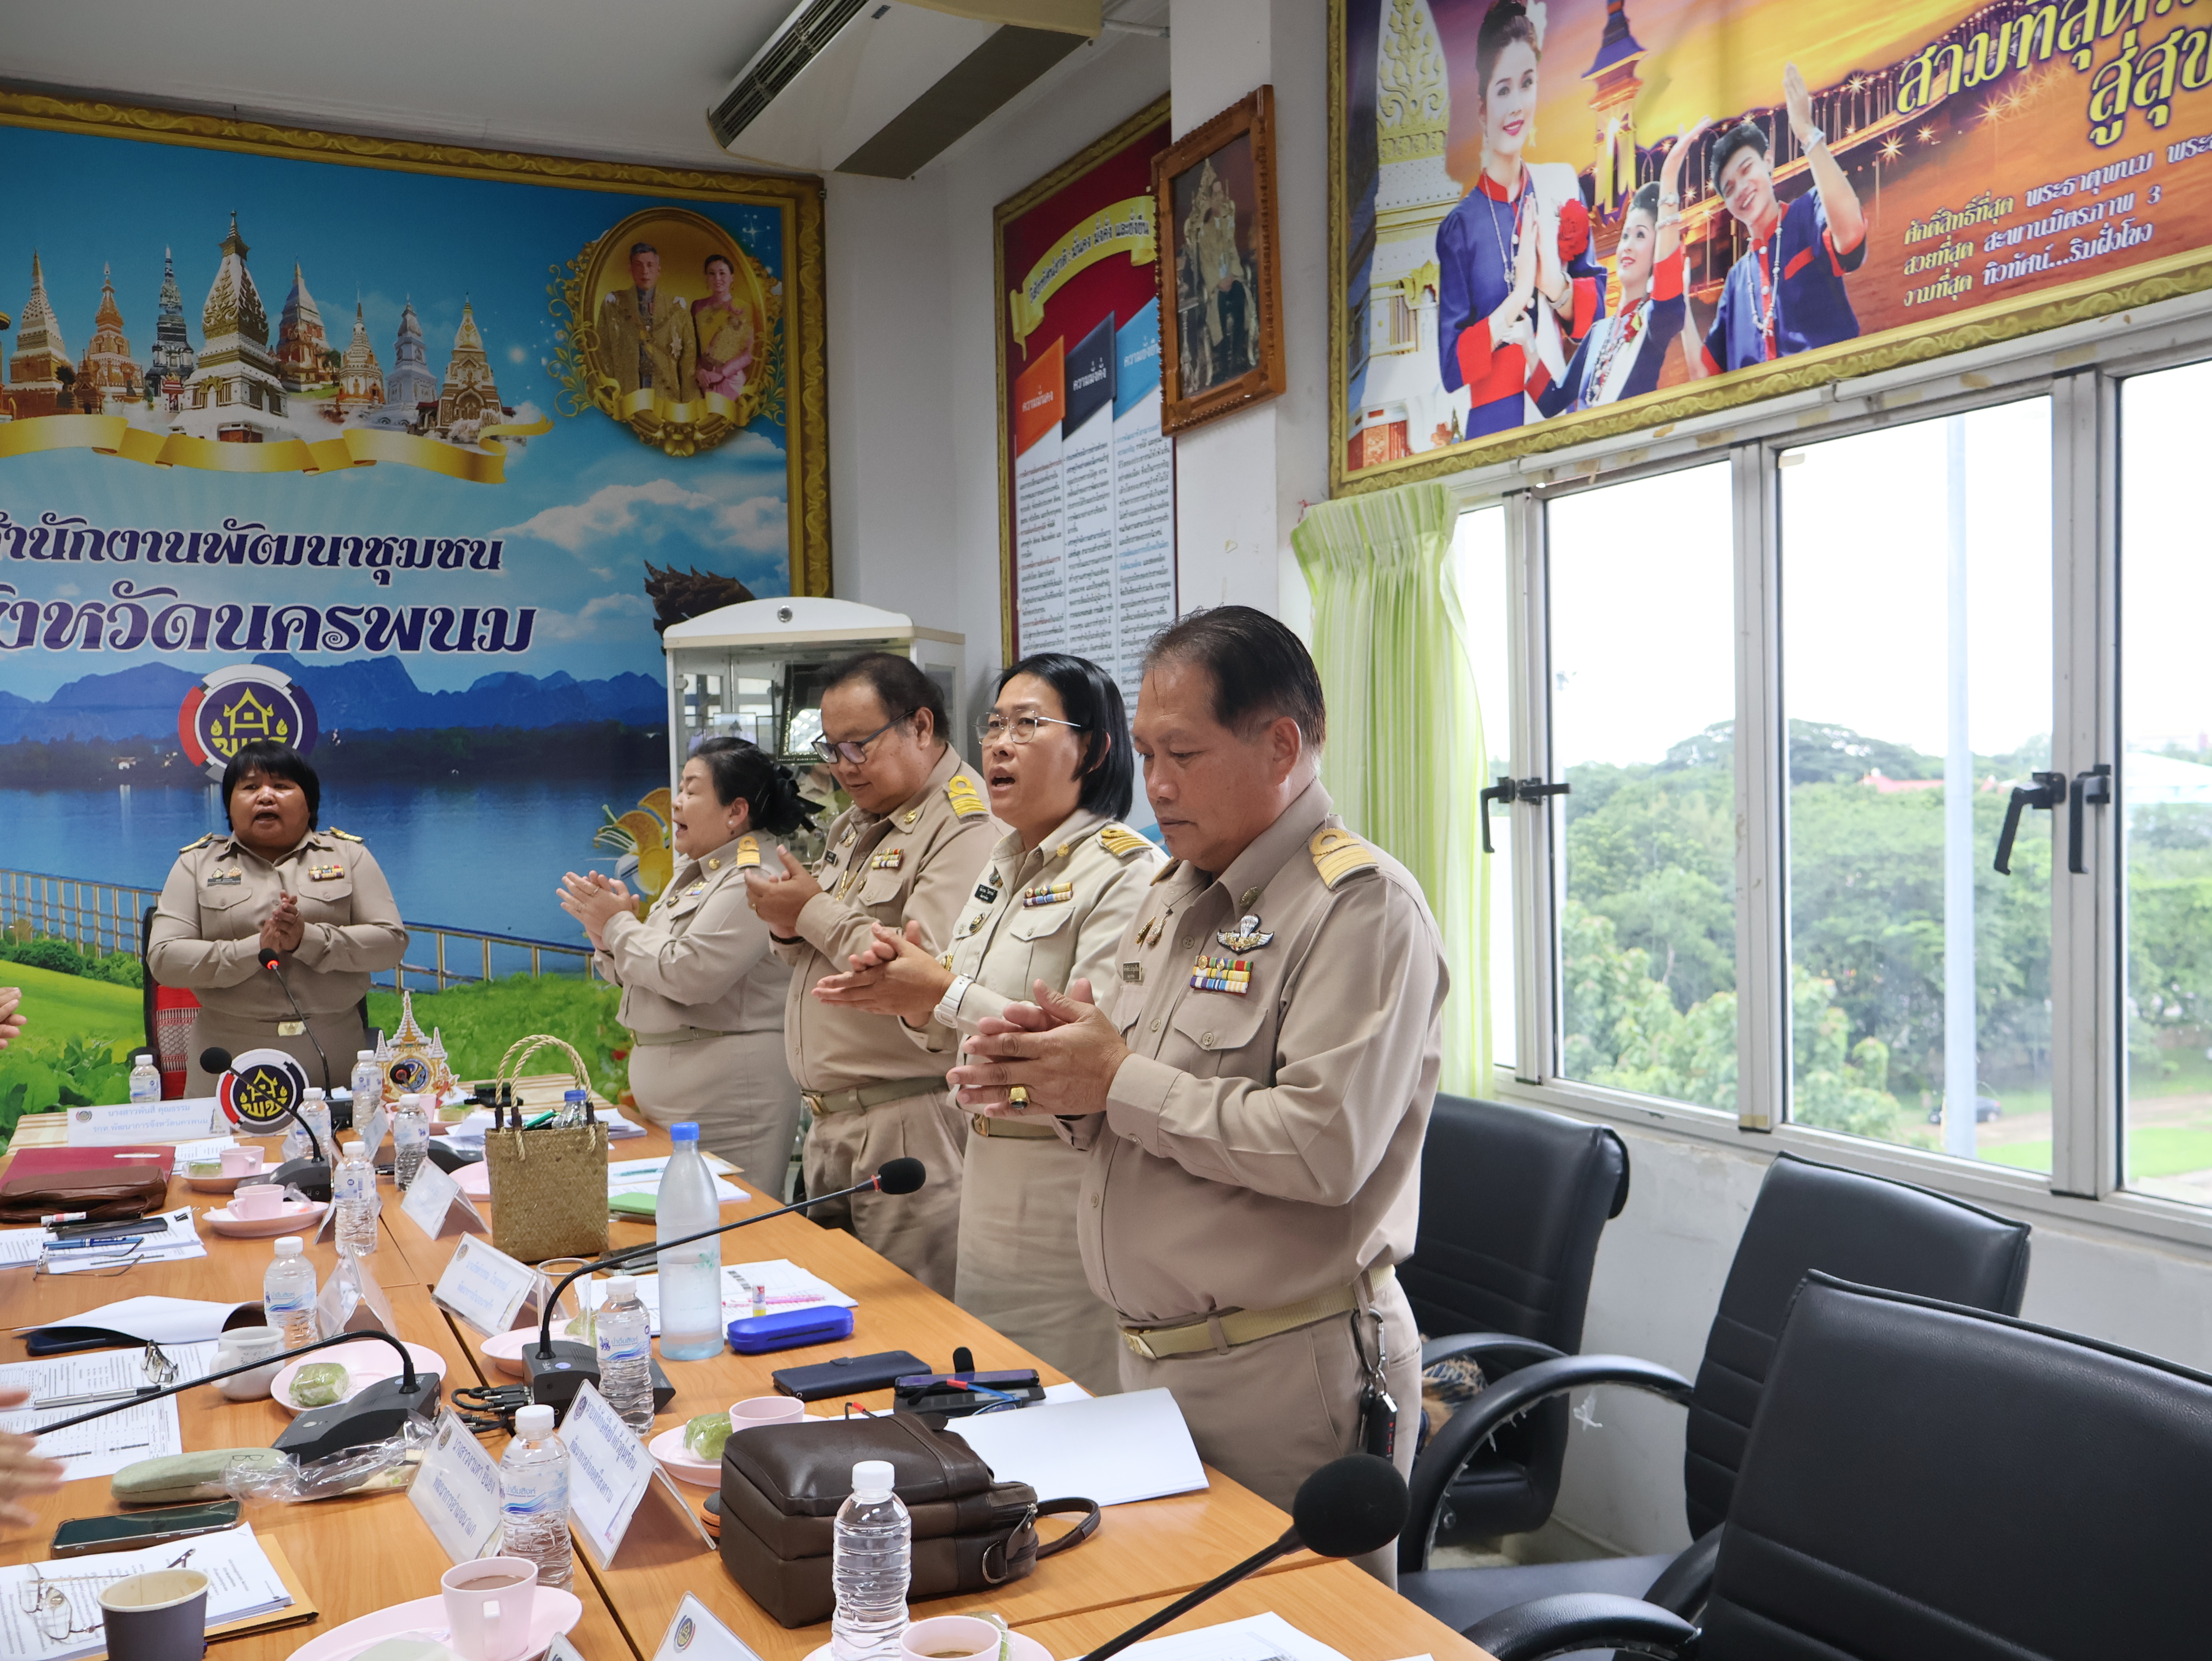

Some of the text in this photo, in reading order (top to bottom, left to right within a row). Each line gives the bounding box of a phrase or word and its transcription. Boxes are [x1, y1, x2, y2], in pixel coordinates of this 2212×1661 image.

[1903, 185, 2161, 276] สวยที่สุด สะพานมิตรภาพ 3
[1904, 190, 2014, 245] ศักดิ์สิทธิ์ที่สุด
[2025, 152, 2154, 207] พระธาตุพนม
[1903, 267, 1972, 307] งามที่สุด
[0, 512, 504, 585] ำนักงานพัฒนาชุมชน
[0, 581, 537, 651] งหวัดนครพนม
[433, 1471, 477, 1538] พัฒนาการอำเภอนาแก
[568, 1435, 614, 1504] พัฒนาการอำเภอศรีสงคราม
